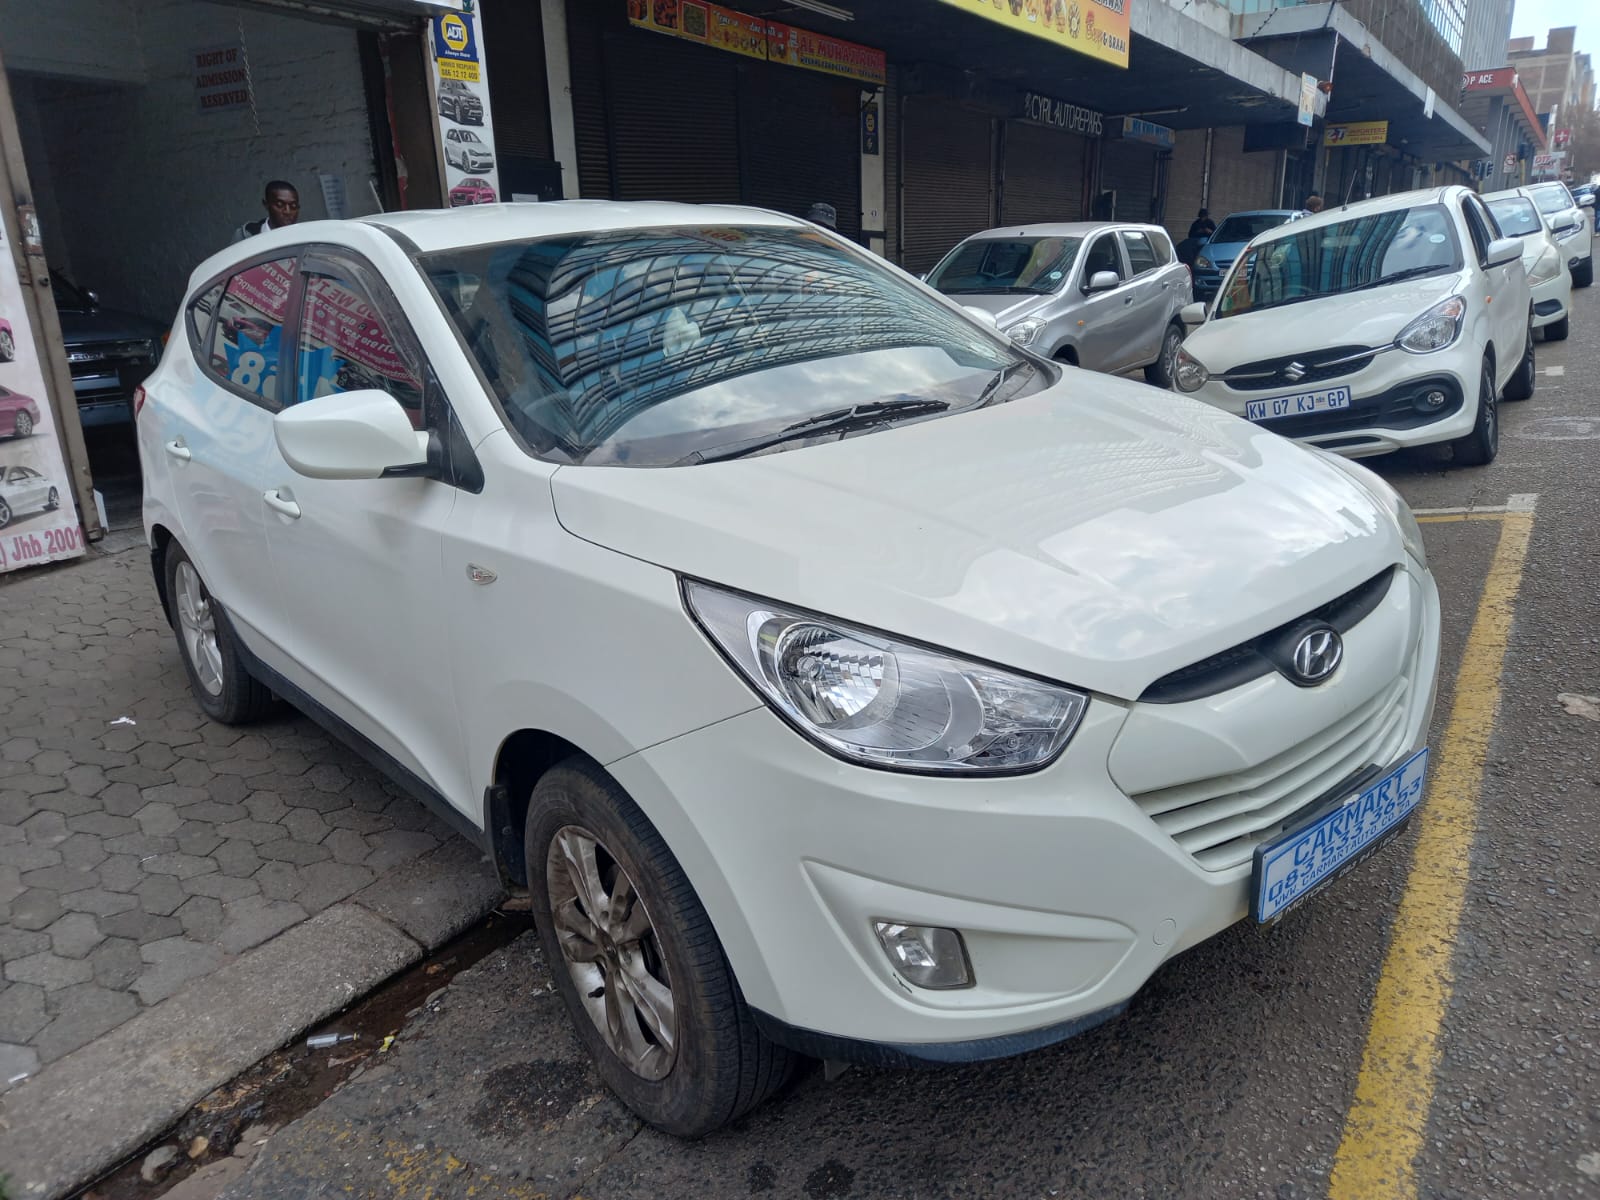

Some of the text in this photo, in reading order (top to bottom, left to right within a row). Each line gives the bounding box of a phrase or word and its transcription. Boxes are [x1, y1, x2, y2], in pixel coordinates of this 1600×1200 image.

[447, 26, 463, 40] ADT
[1109, 34, 1126, 53] BRAAI
[196, 47, 237, 68] RIGHT OF
[196, 68, 246, 89] ADMISSION
[200, 88, 247, 108] RESERVED
[1249, 390, 1346, 420] KW 07 KJ GP
[44, 525, 85, 554] 2001
[1293, 768, 1408, 867] CARMART
[1268, 855, 1315, 903] 083
[1321, 819, 1366, 863] 533
[1371, 776, 1422, 826] 3653
